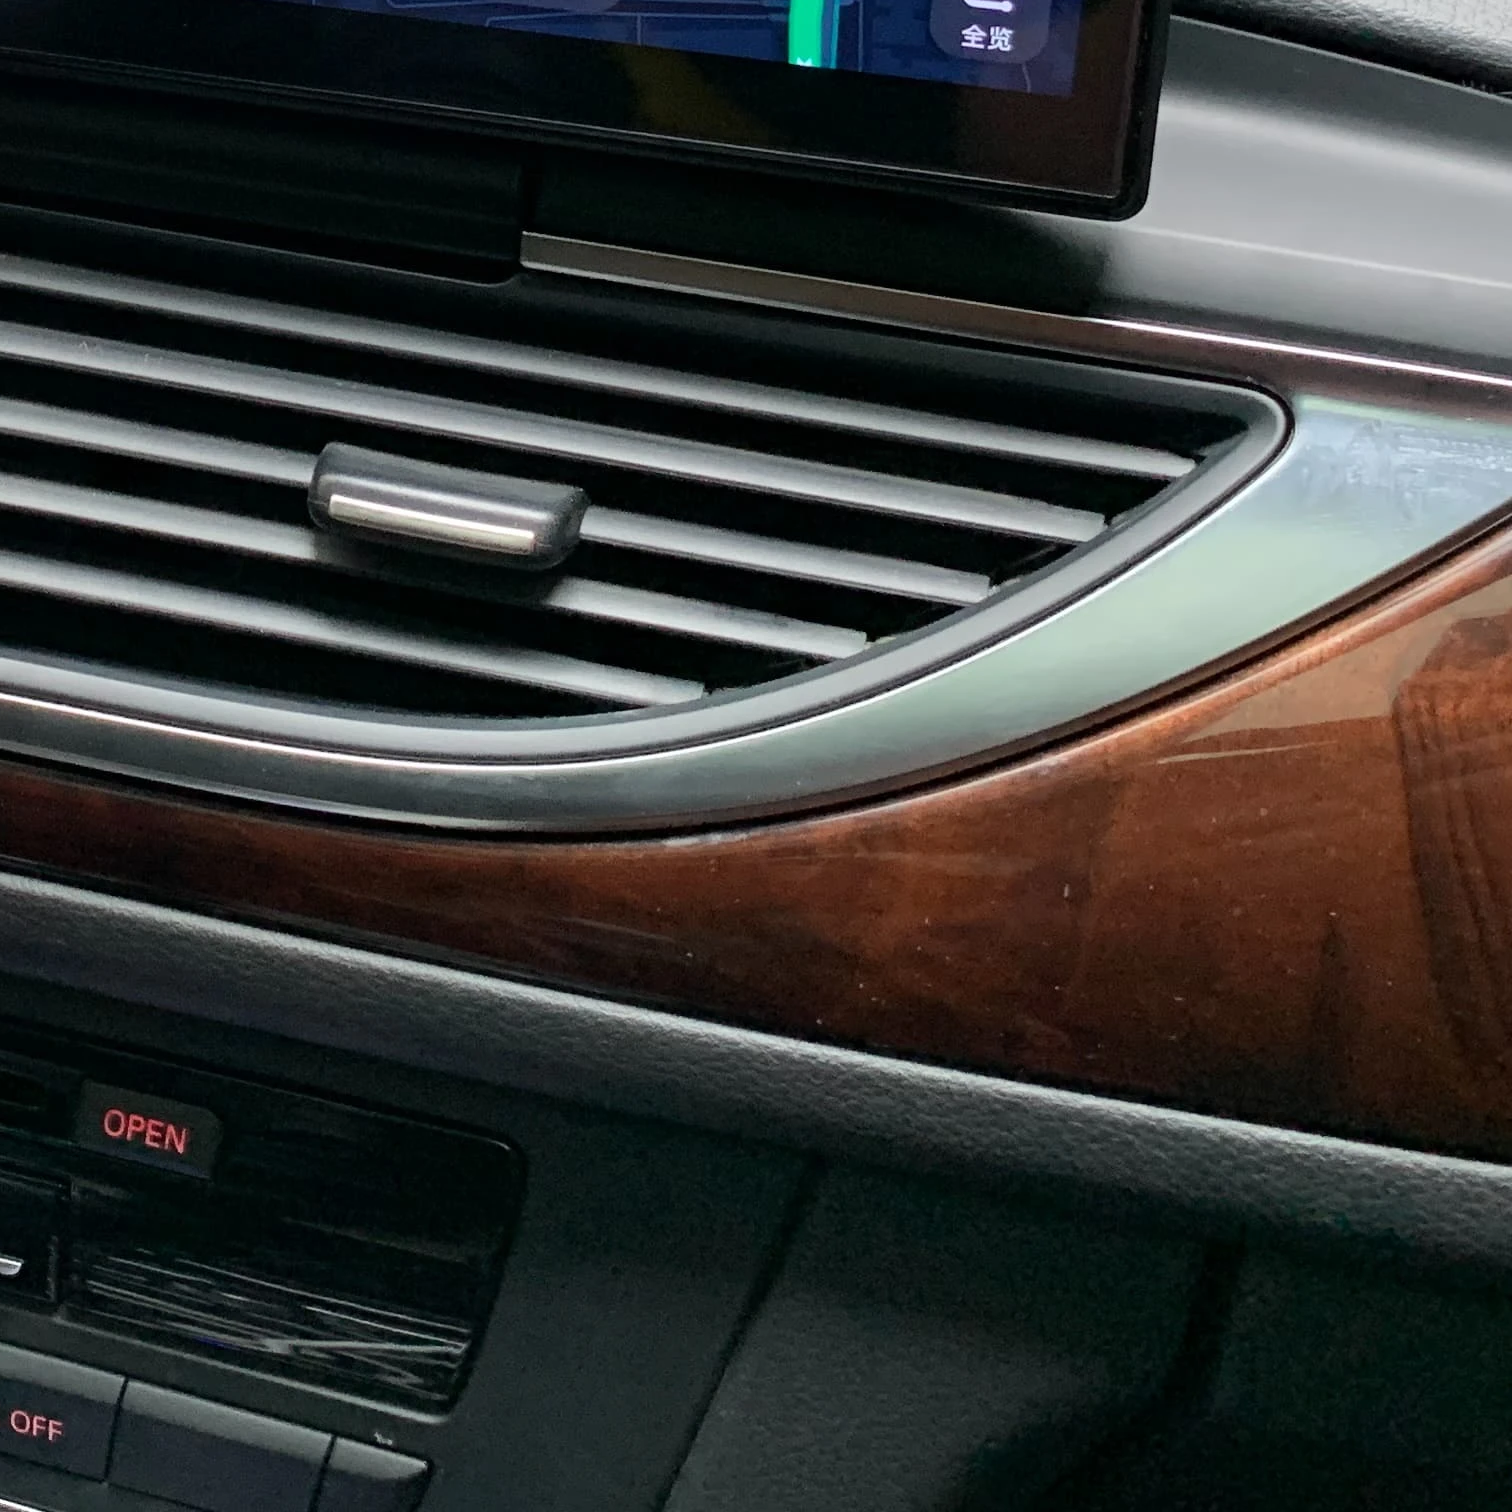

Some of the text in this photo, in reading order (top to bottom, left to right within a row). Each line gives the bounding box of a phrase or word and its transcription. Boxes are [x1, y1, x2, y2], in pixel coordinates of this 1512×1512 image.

[961, 24, 1014, 52] 全览
[103, 1108, 189, 1156] OPEN
[10, 1408, 65, 1442] OFF
